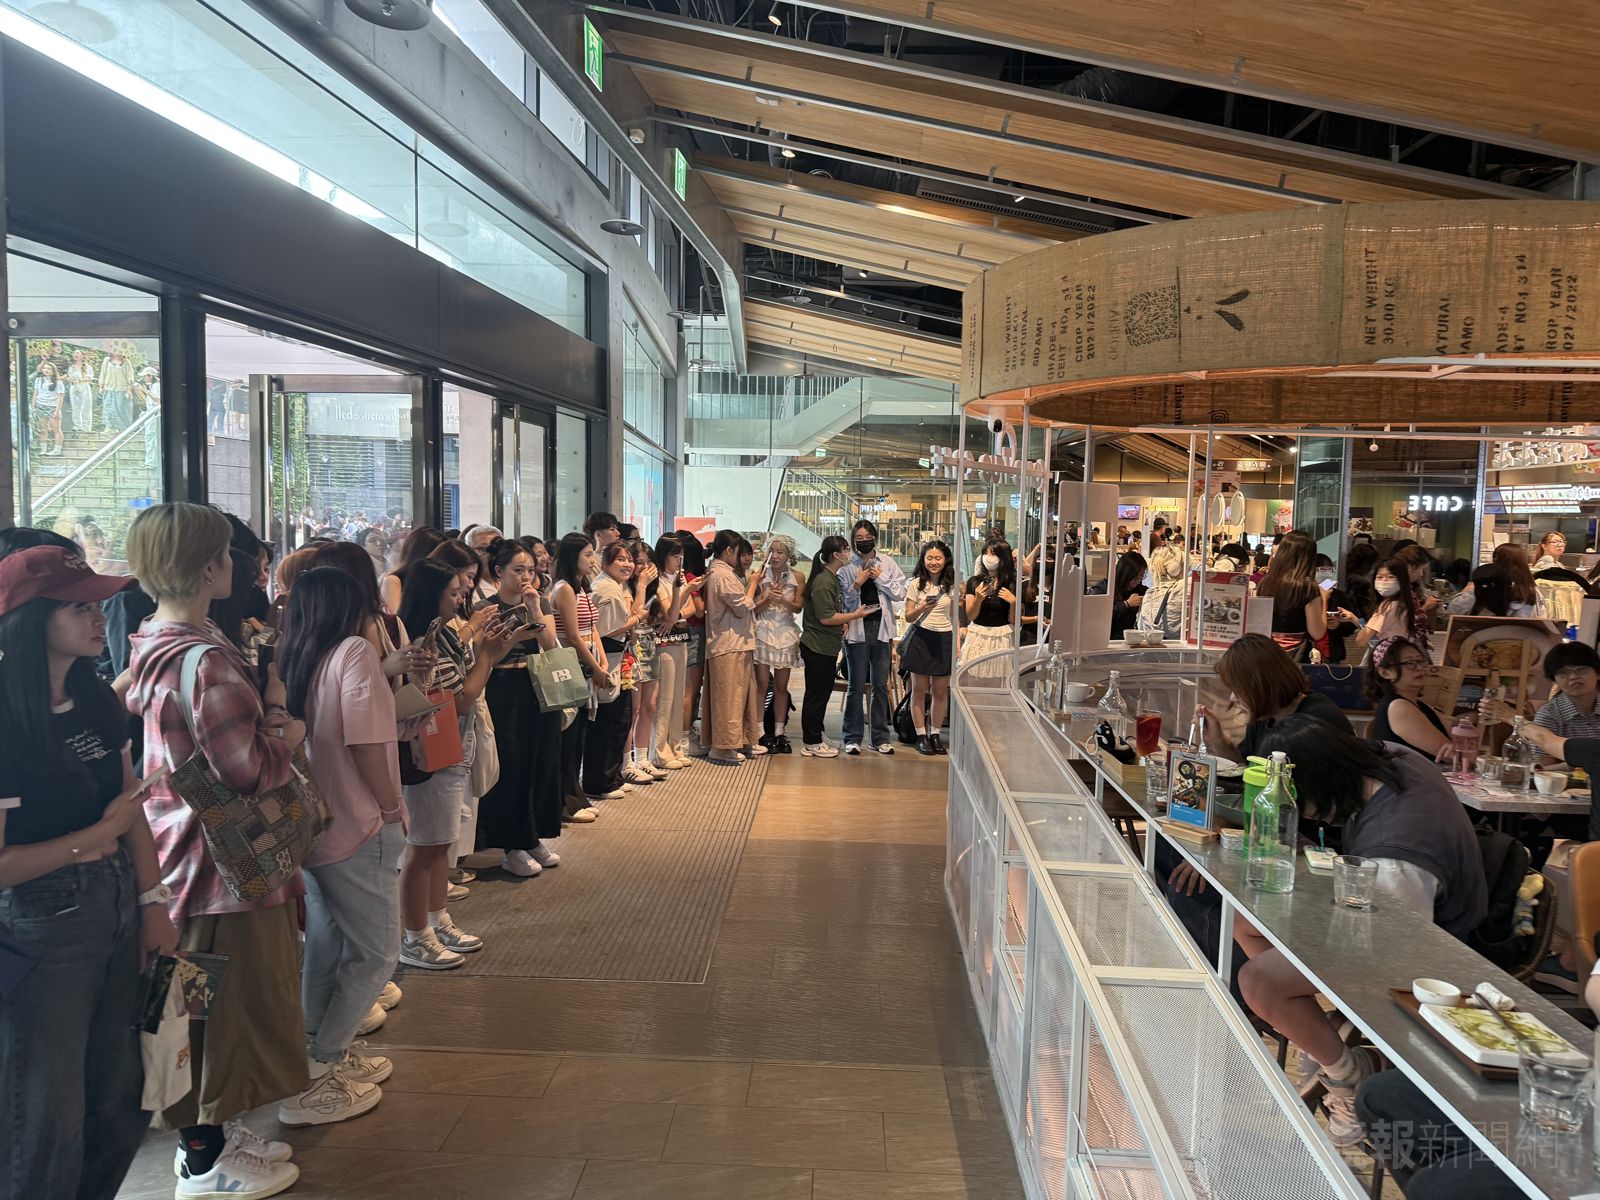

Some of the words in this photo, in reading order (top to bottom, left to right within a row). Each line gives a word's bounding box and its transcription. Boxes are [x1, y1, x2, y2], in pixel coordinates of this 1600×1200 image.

[1364, 248, 1378, 309] WEIGHT
[1548, 267, 1563, 310] YEAR
[1004, 294, 1012, 344] WEIGHT
[1074, 283, 1083, 320] YEAR
[1086, 283, 1096, 361] 2021/2022
[1020, 306, 1029, 367] NATURAL
[1032, 317, 1043, 368] SIDAMO
[1074, 326, 1083, 363] CROP
[1364, 315, 1377, 345] NET
[1382, 303, 1395, 345] 30.00
[1057, 345, 1067, 379] CERT
